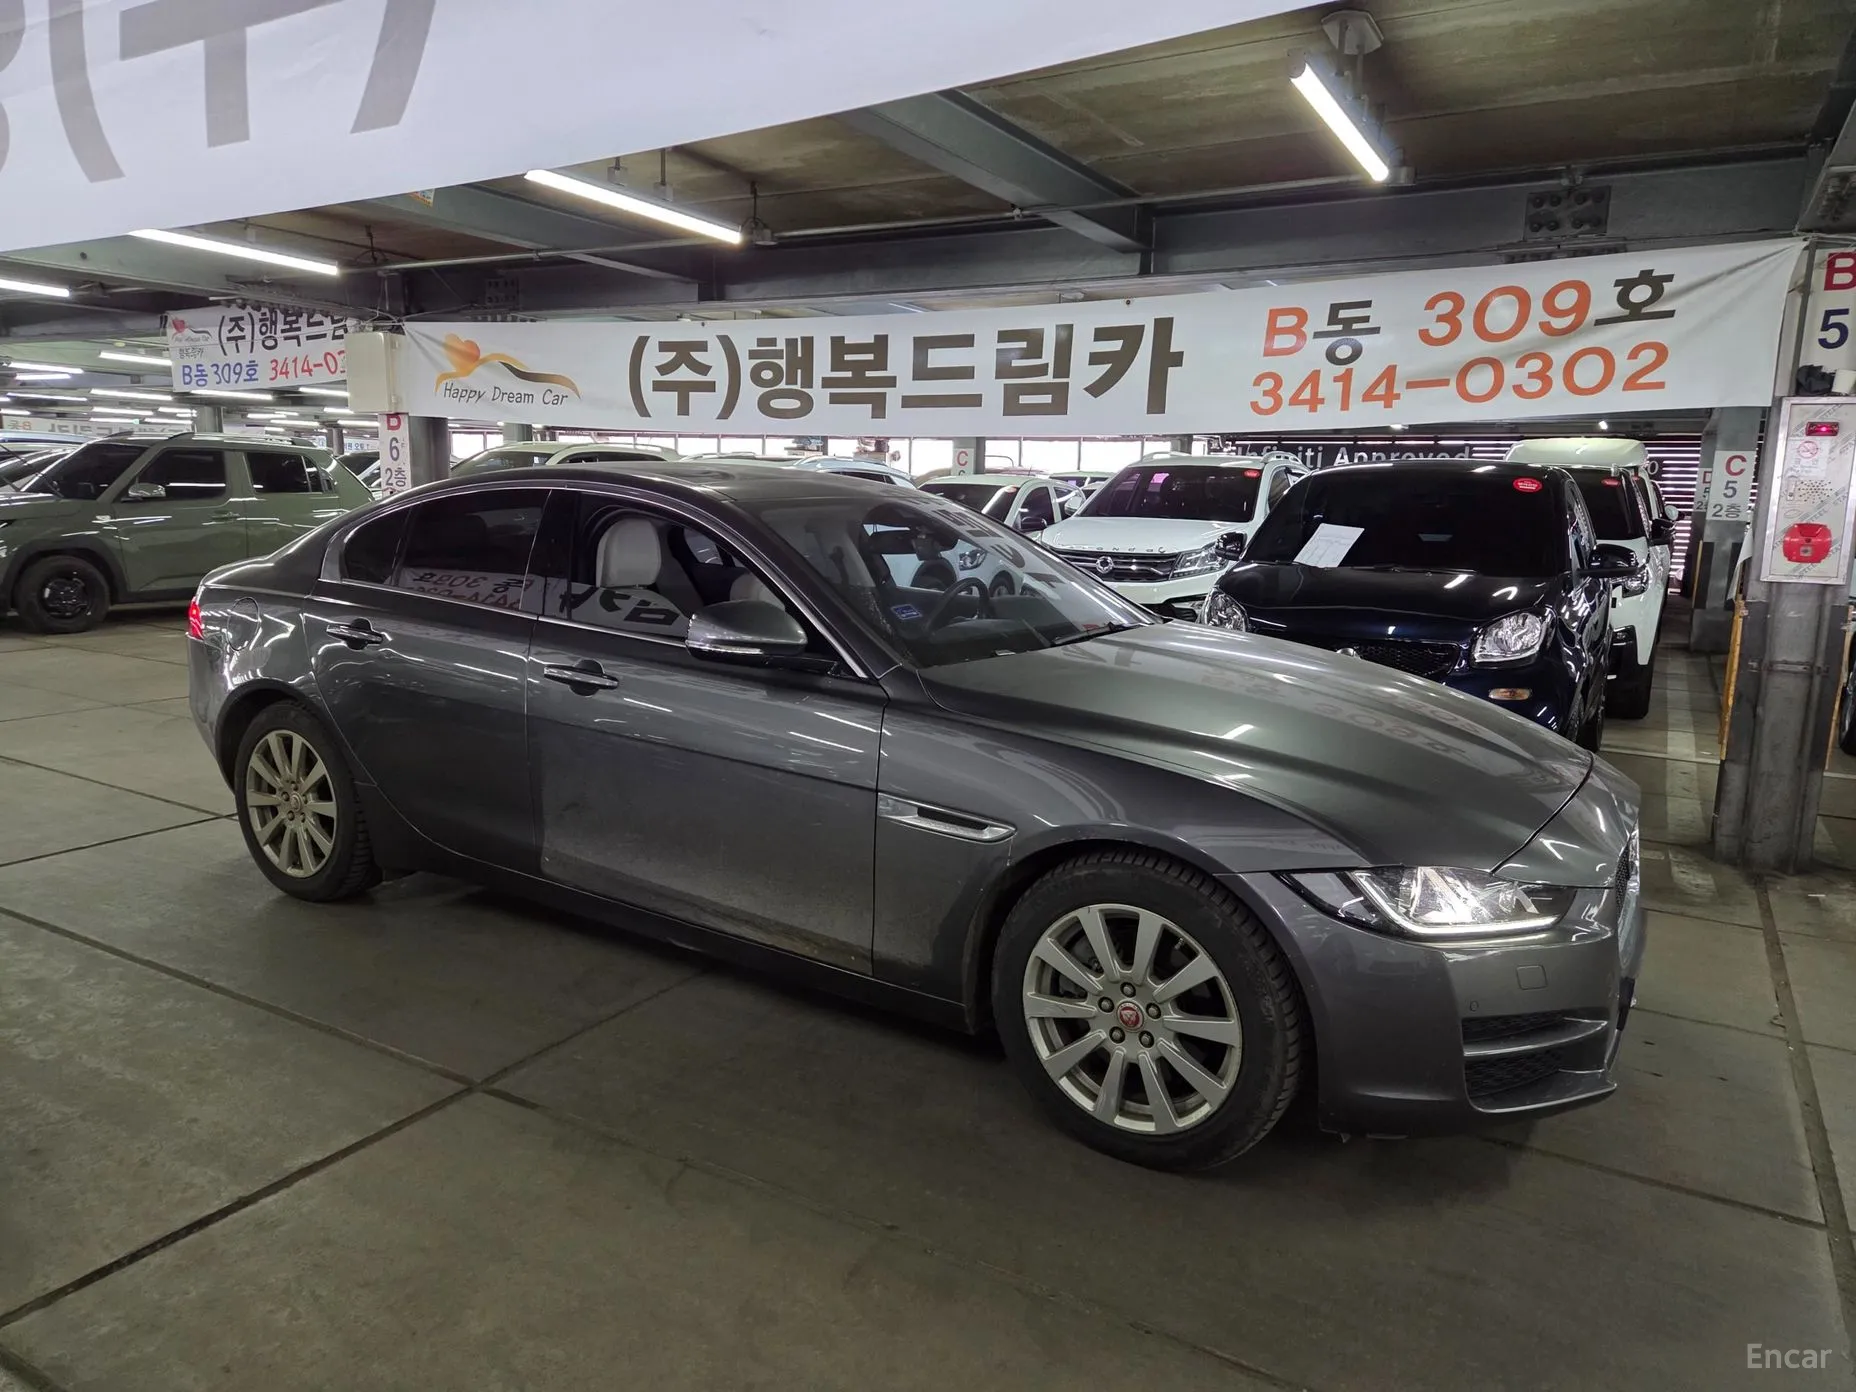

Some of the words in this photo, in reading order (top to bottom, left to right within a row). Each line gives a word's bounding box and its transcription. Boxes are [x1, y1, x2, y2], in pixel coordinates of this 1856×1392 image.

[1824, 252, 1856, 292] B
[1263, 300, 1381, 366] B동
[1418, 269, 1676, 347] 309호
[1818, 308, 1850, 350] 5
[182, 363, 208, 387] B동
[211, 360, 259, 385] 309호
[628, 316, 1184, 420] (주)행복드림카
[1250, 341, 1670, 416] 3414-0302
[443, 382, 486, 403] Happy
[492, 386, 534, 404] Dream
[542, 388, 568, 406] Car
[389, 437, 400, 461] 6
[957, 450, 969, 467] C
[385, 467, 407, 487] 2층
[1725, 454, 1747, 476] C
[1723, 480, 1738, 499] 5
[1712, 503, 1742, 519] 2층
